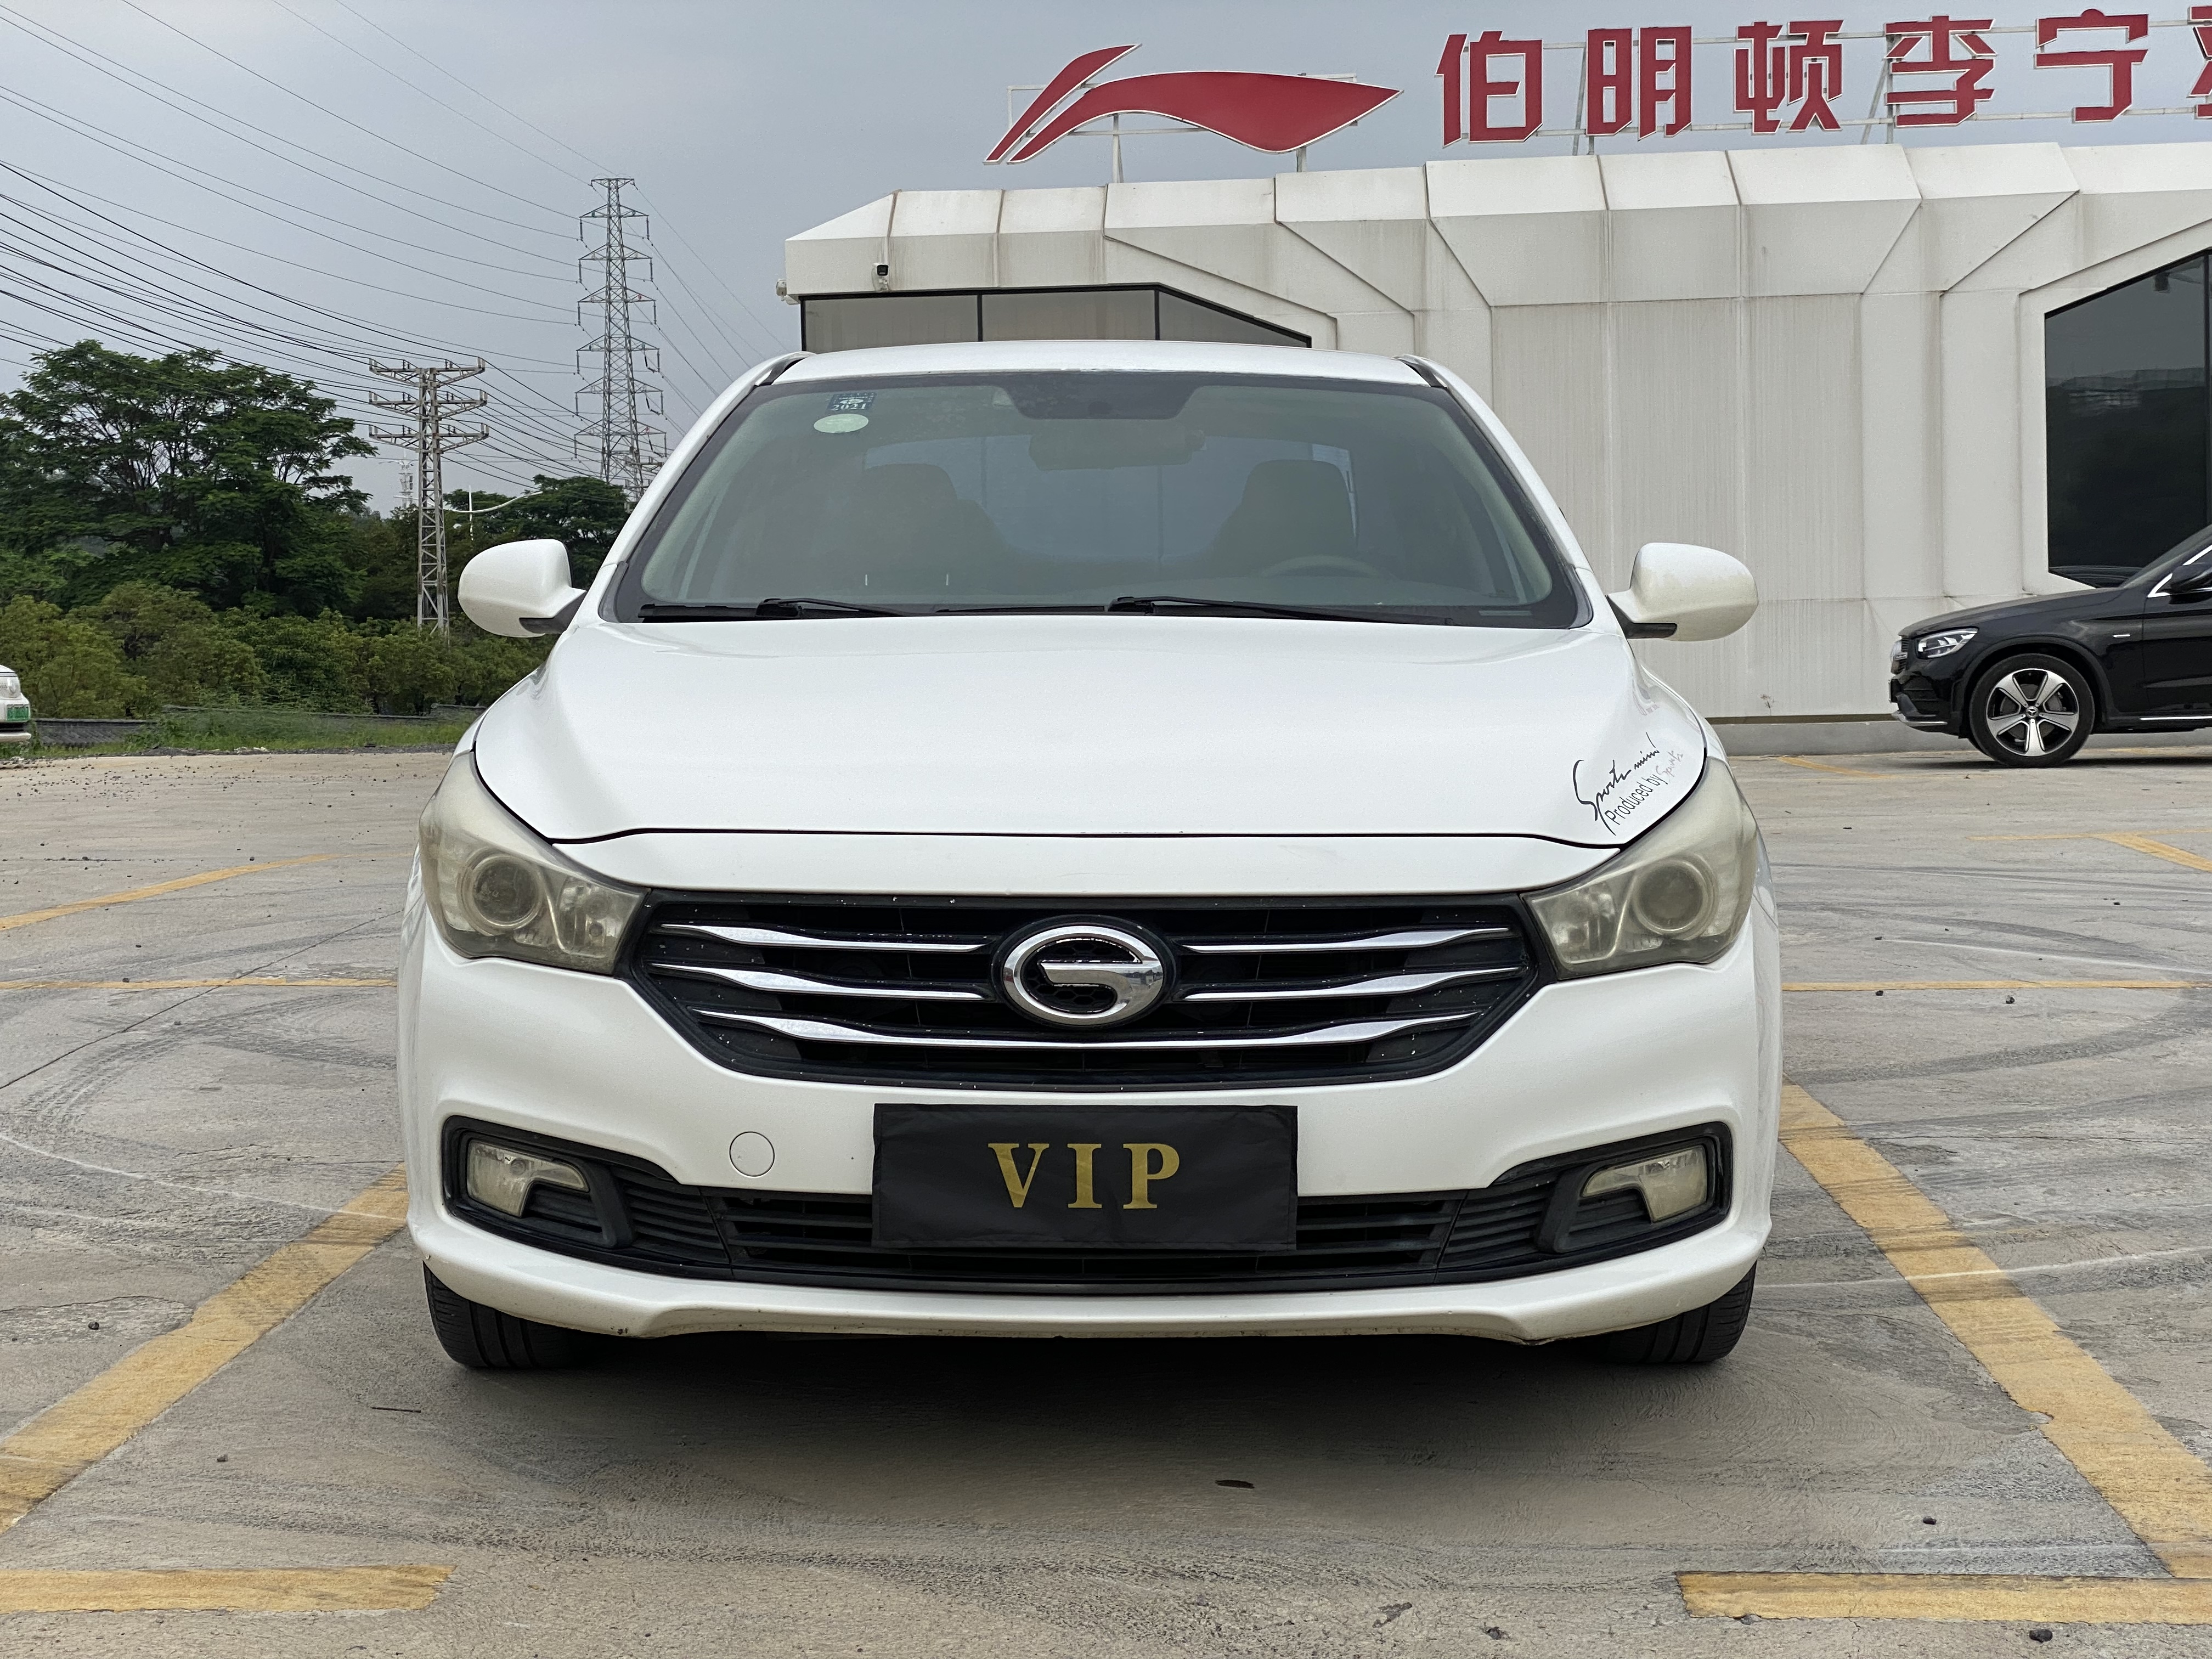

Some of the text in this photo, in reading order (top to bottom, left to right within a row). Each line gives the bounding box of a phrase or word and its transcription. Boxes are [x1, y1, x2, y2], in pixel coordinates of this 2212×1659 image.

[1436, 5, 2212, 145] 伯明顿李宁
[831, 402, 866, 411] 2021
[1604, 781, 1654, 826] Produced
[1641, 774, 1669, 787] by
[988, 1142, 1181, 1210] VIP
